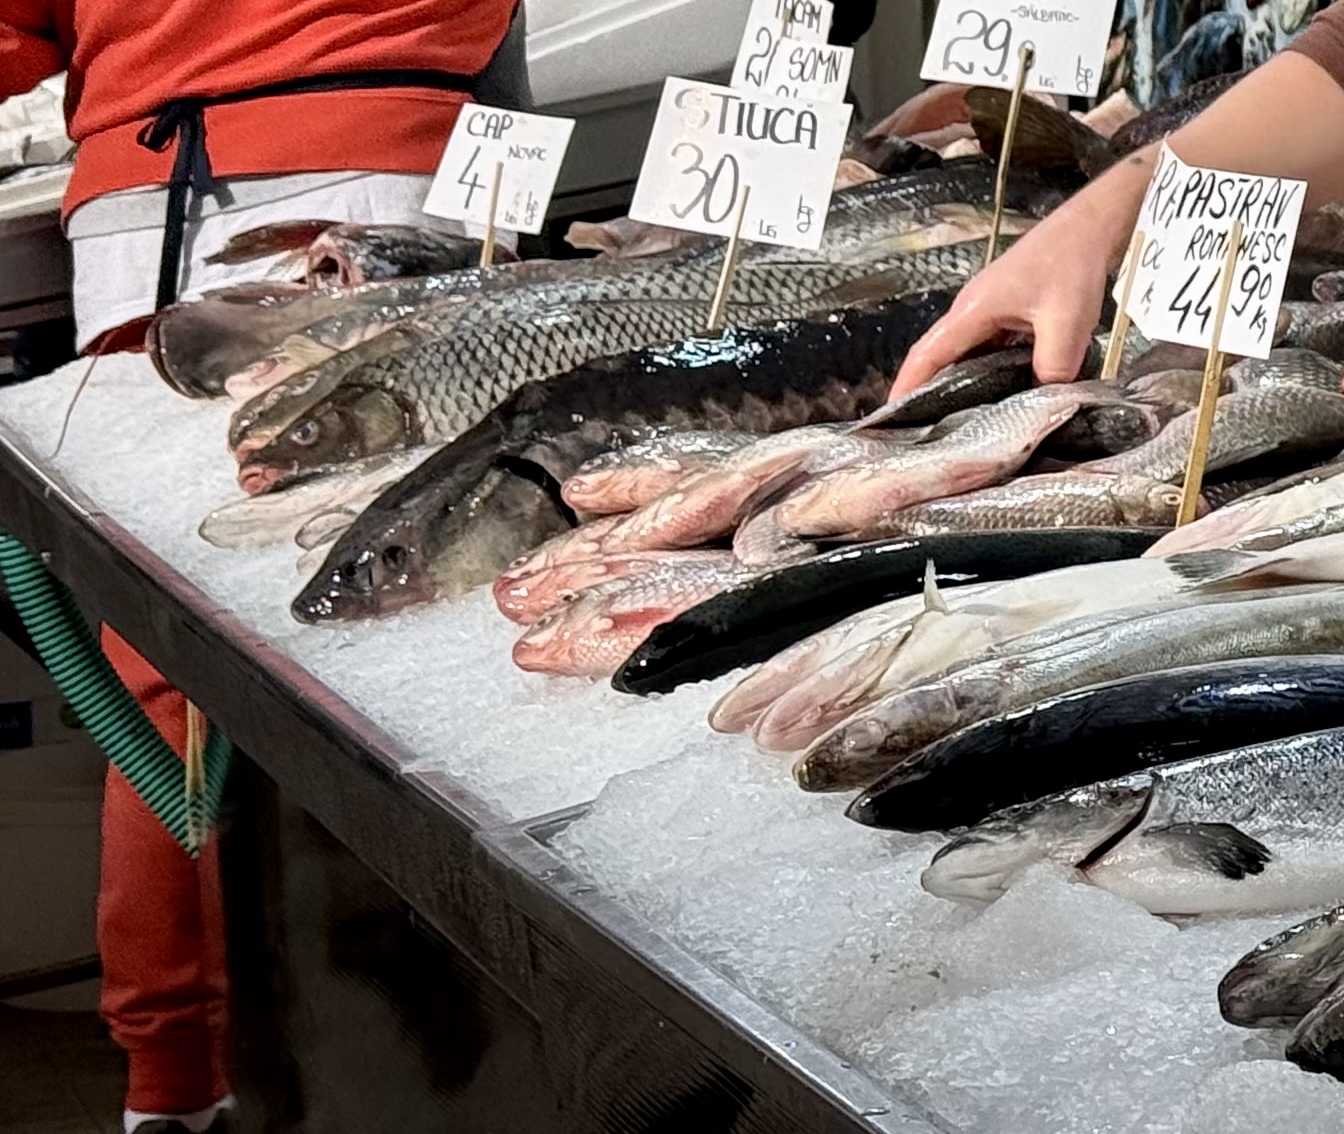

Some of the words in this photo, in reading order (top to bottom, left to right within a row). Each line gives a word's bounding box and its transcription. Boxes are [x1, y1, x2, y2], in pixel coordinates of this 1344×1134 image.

[788, 46, 844, 85] SOMN
[467, 110, 514, 140] CAP
[669, 141, 740, 224] 30
